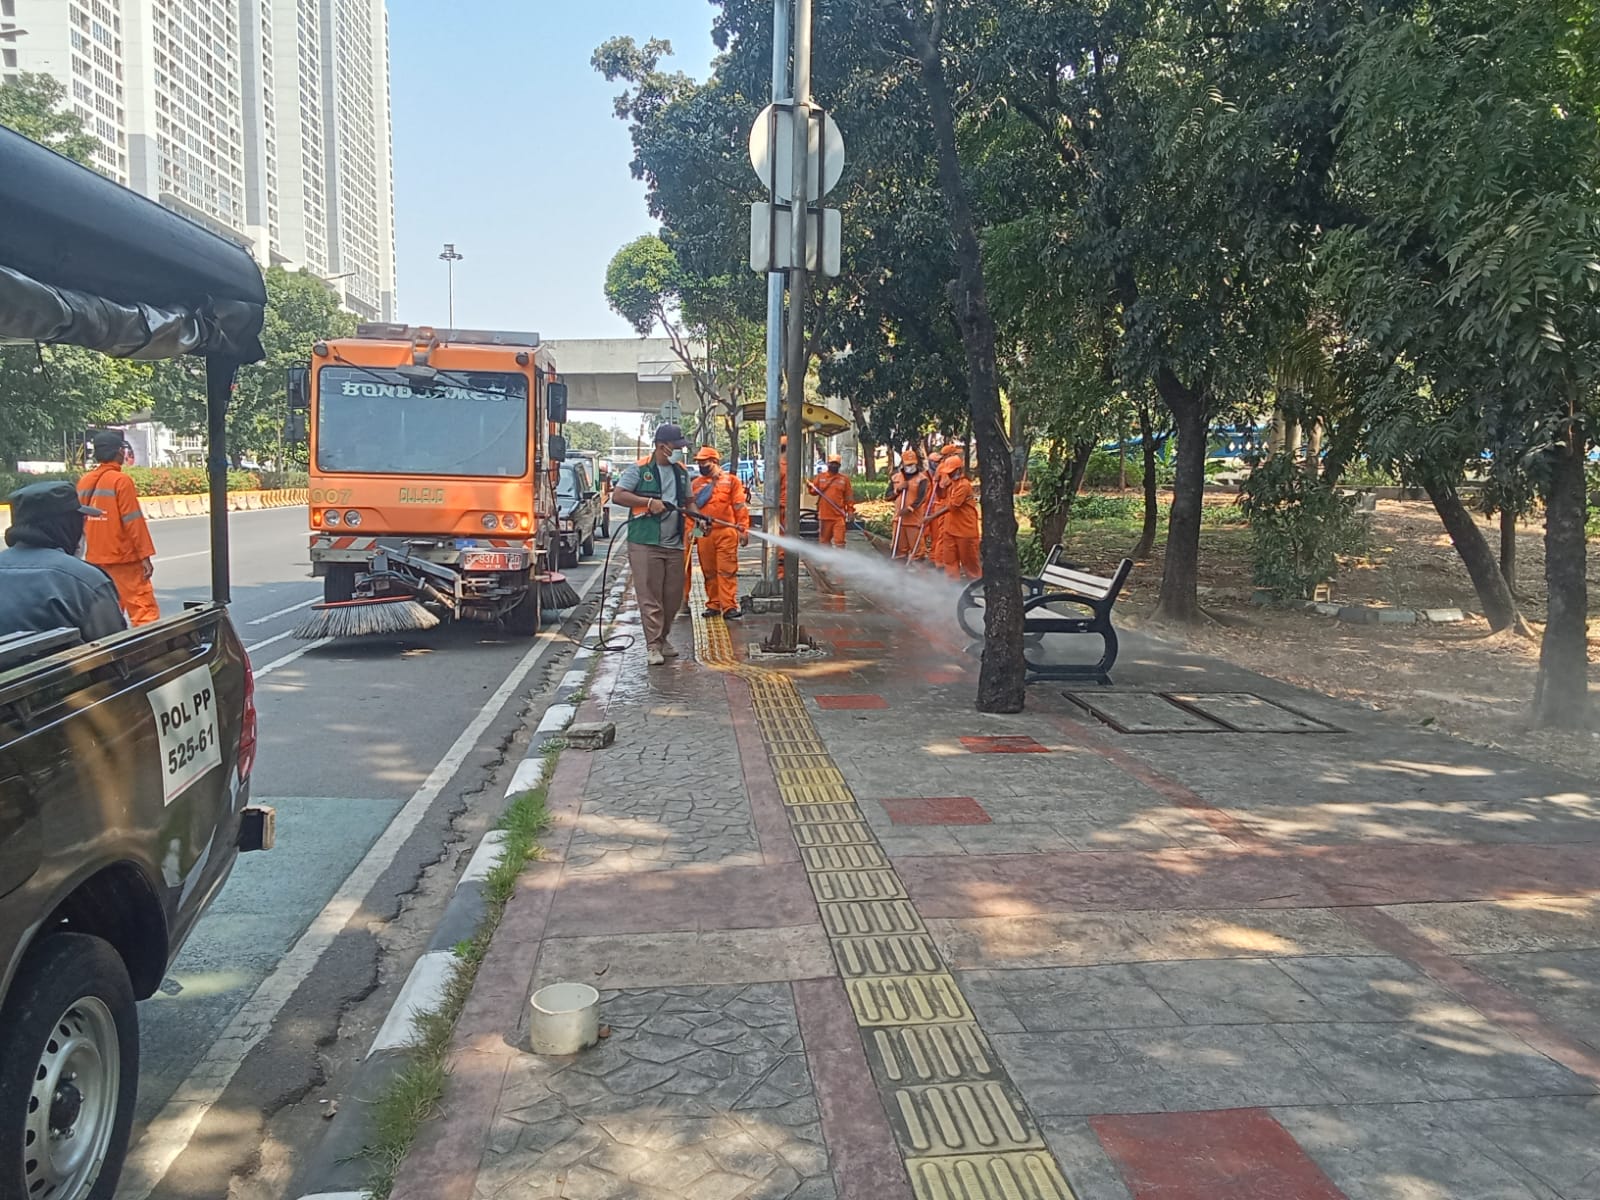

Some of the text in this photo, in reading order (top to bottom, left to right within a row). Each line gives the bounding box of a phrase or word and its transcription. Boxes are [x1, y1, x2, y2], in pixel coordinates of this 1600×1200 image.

[341, 382, 412, 398] BOND
[311, 488, 352, 505] 007
[160, 688, 211, 736] POL PP
[168, 723, 214, 775] 525-61
